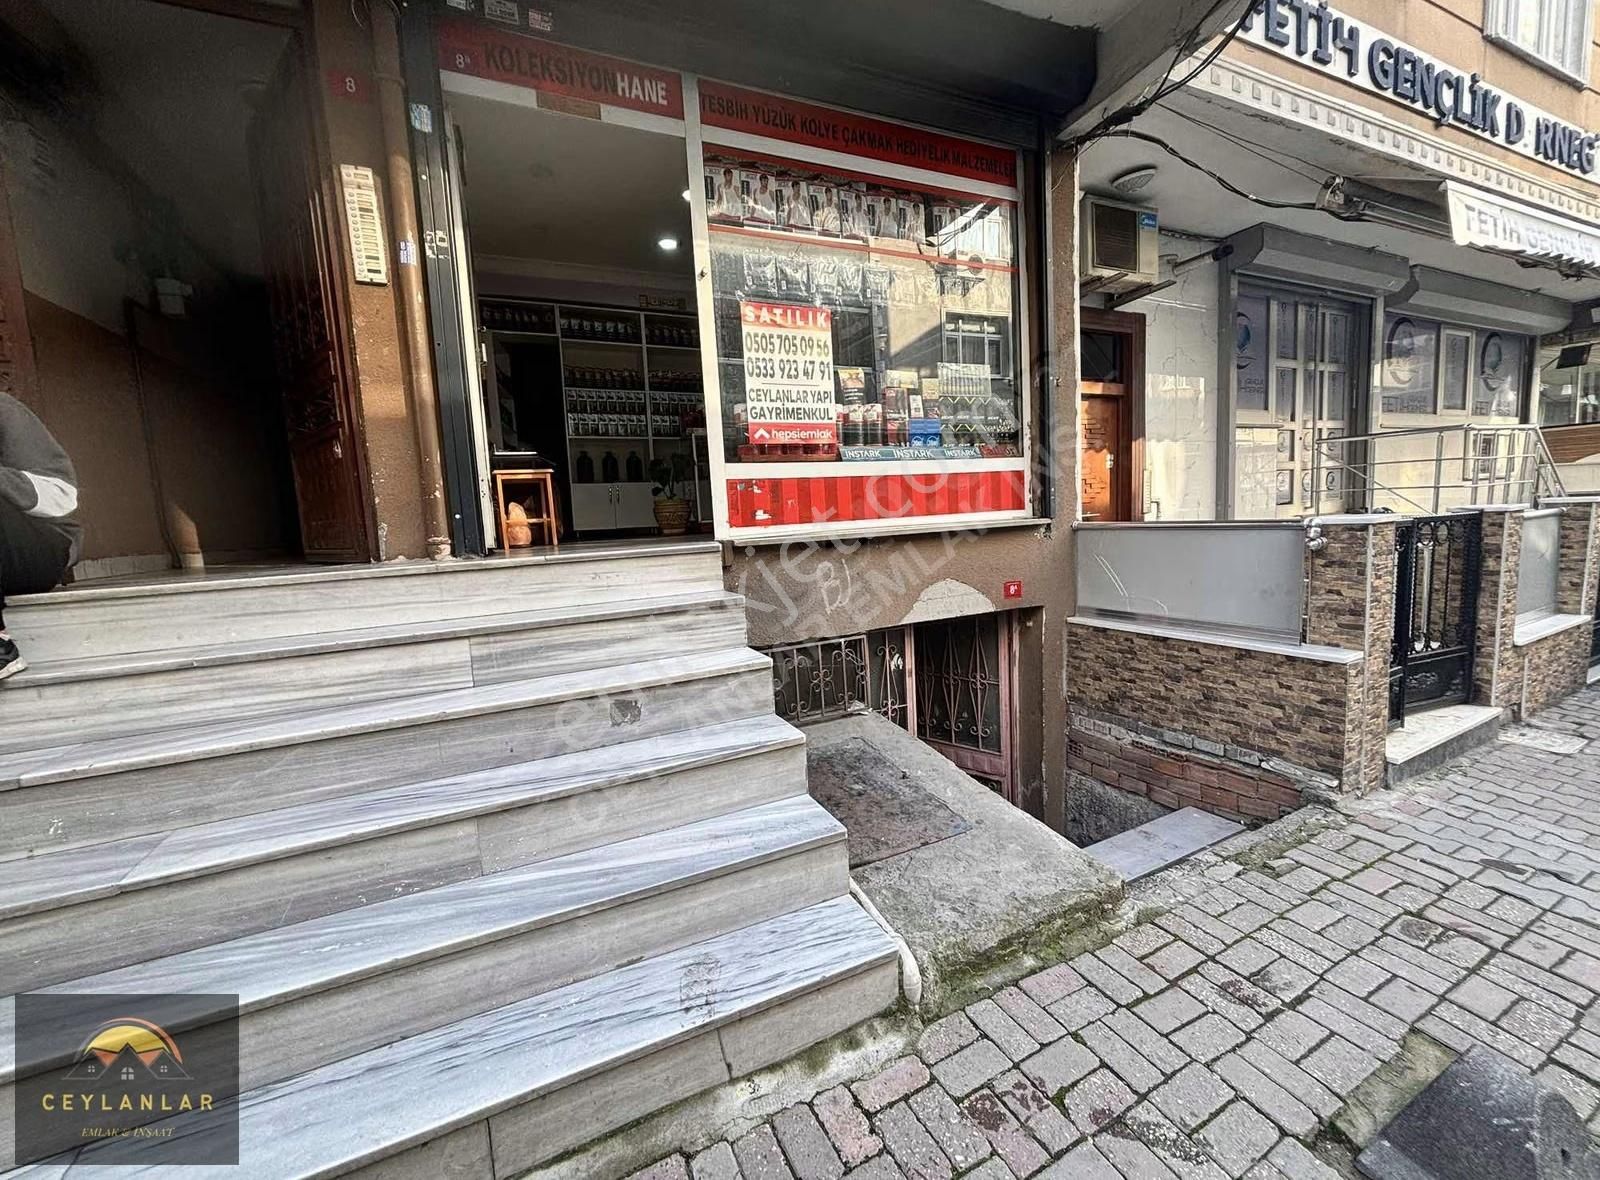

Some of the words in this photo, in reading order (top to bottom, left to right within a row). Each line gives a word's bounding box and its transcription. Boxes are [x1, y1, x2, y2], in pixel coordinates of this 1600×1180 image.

[345, 77, 356, 93] 8
[1367, 38, 1501, 137] GENÇLİK
[800, 117, 838, 141] KOLYE
[744, 305, 827, 328] SATILIK
[745, 332, 775, 354] 0505
[776, 334, 798, 355] 705
[800, 336, 814, 356] 09
[816, 339, 830, 357] 56
[746, 357, 775, 380] 0533
[778, 359, 799, 380] 923
[802, 360, 816, 381] 47
[818, 361, 832, 381] 91
[748, 388, 809, 404] CEYLANLAR
[810, 390, 832, 404] YAPI
[749, 403, 833, 420] GAYRİMENKUL
[771, 428, 833, 441] hepsiemlak
